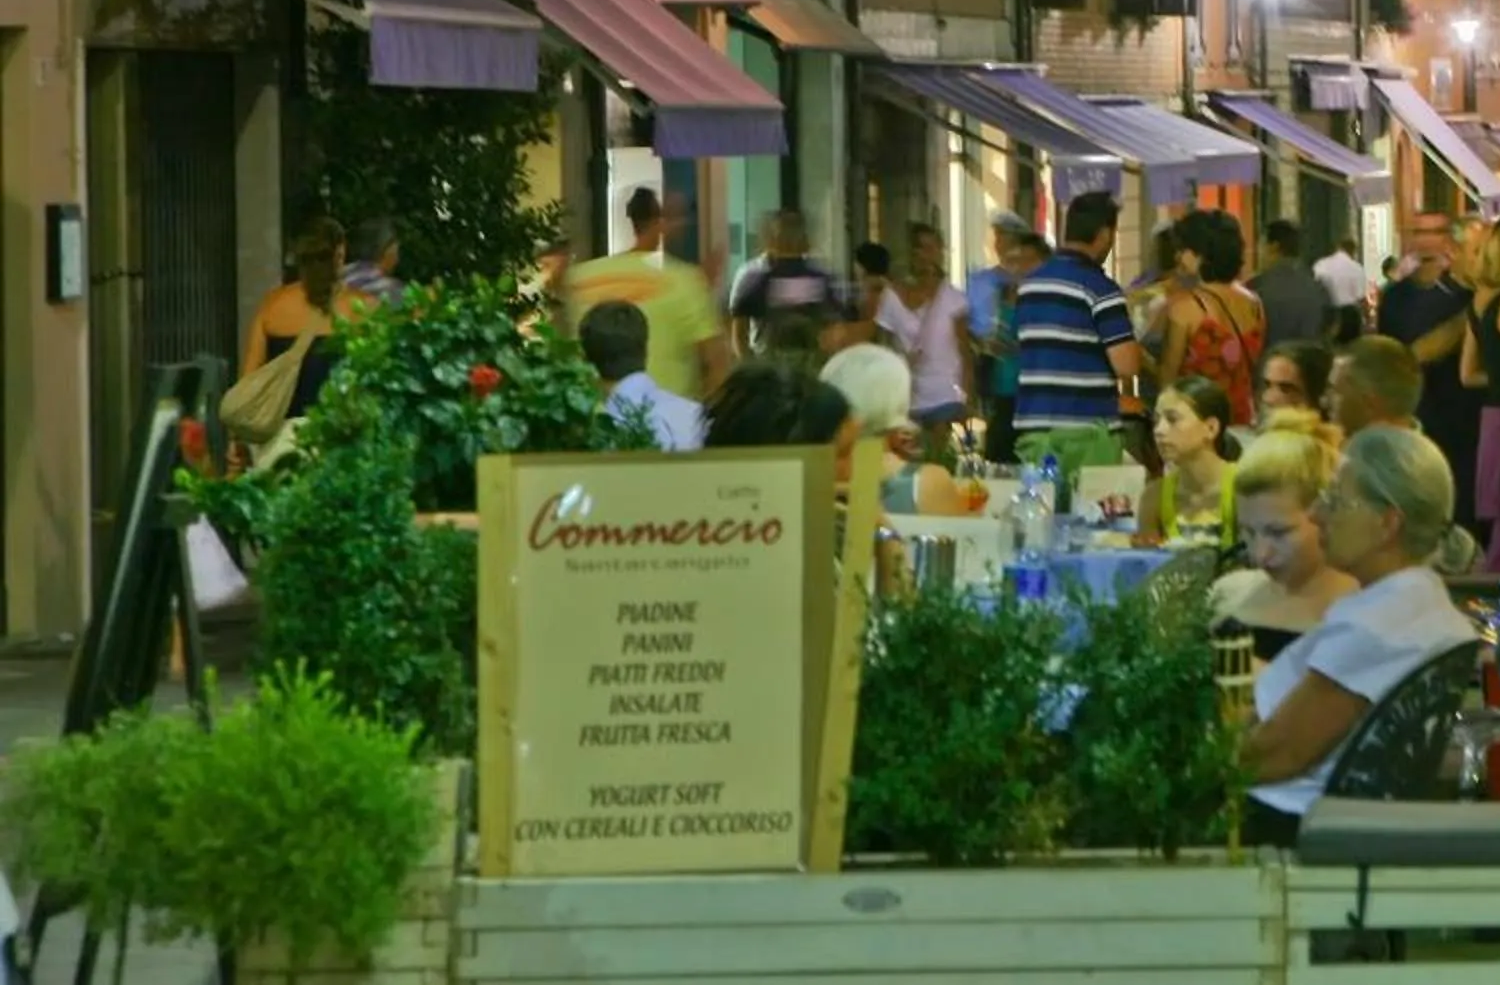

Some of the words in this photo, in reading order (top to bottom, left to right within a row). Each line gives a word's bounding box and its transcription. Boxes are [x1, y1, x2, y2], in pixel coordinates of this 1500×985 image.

[528, 489, 784, 552] Commercio
[616, 599, 700, 624] PIADINE
[621, 631, 694, 655] PANINI
[587, 662, 649, 687] PIATTI
[652, 659, 727, 684] FREDDI
[608, 691, 703, 715] INSALATE
[578, 723, 651, 748] FRUTTA
[656, 721, 732, 745] FRESCA
[588, 783, 671, 808] YOGURT
[673, 781, 726, 805] SOFT
[514, 818, 561, 842] CON
[563, 814, 648, 840] CEREALI
[651, 815, 665, 838] E
